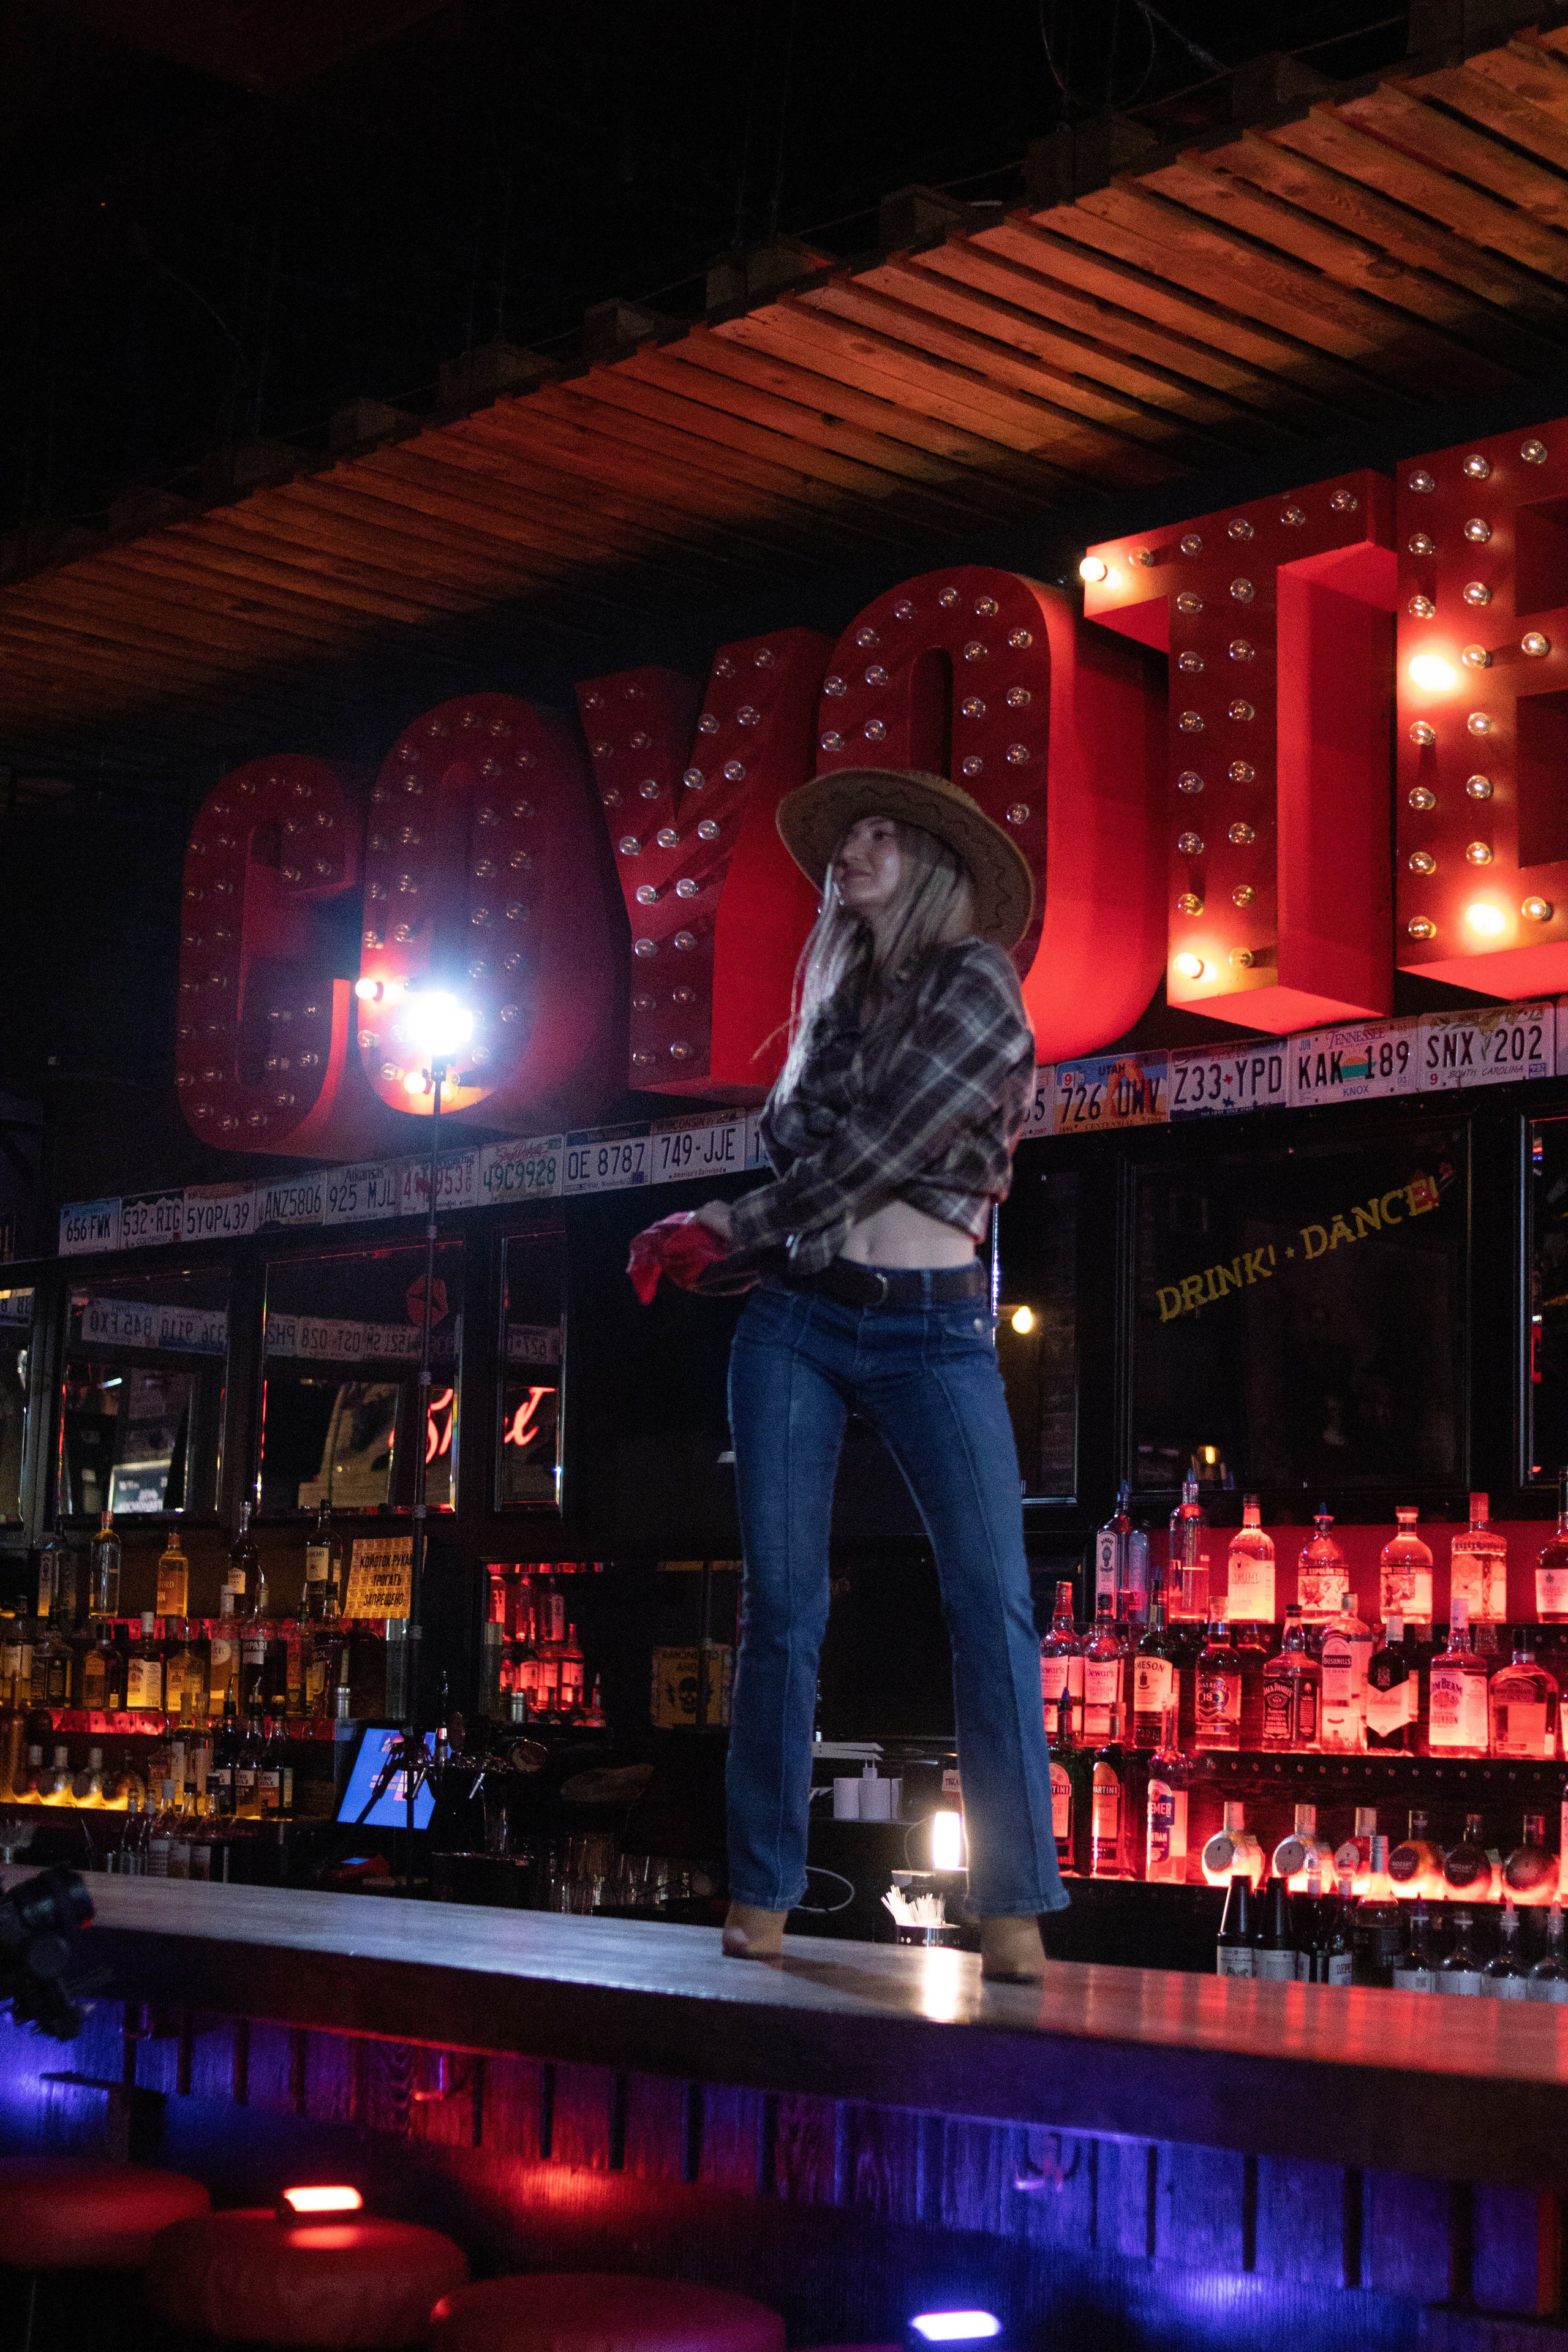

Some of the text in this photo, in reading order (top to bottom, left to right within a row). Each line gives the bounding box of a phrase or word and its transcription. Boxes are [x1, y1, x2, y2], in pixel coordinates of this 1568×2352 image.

[1325, 1026, 1385, 1049] TENNESSEE
[1425, 1025, 1543, 1069] SNX 202
[1098, 1063, 1126, 1076] UTAH
[1298, 1040, 1409, 1090] KAK 189
[1428, 1072, 1439, 1085] 9
[1063, 1074, 1072, 1087] 9
[1174, 1055, 1283, 1105] Z33 YPD
[1342, 1084, 1370, 1098] KNOX
[1061, 1084, 1102, 1123] 726
[598, 1142, 645, 1177] 8787
[265, 1185, 322, 1219] ANZ5806
[328, 1183, 358, 1213] 925
[368, 1175, 396, 1210] MJL
[1156, 1243, 1278, 1323] DRINK!
[1087, 1668, 1115, 1677] Dewar's
[1136, 1660, 1164, 1673] MESON
[1052, 1785, 1070, 1795] TINI
